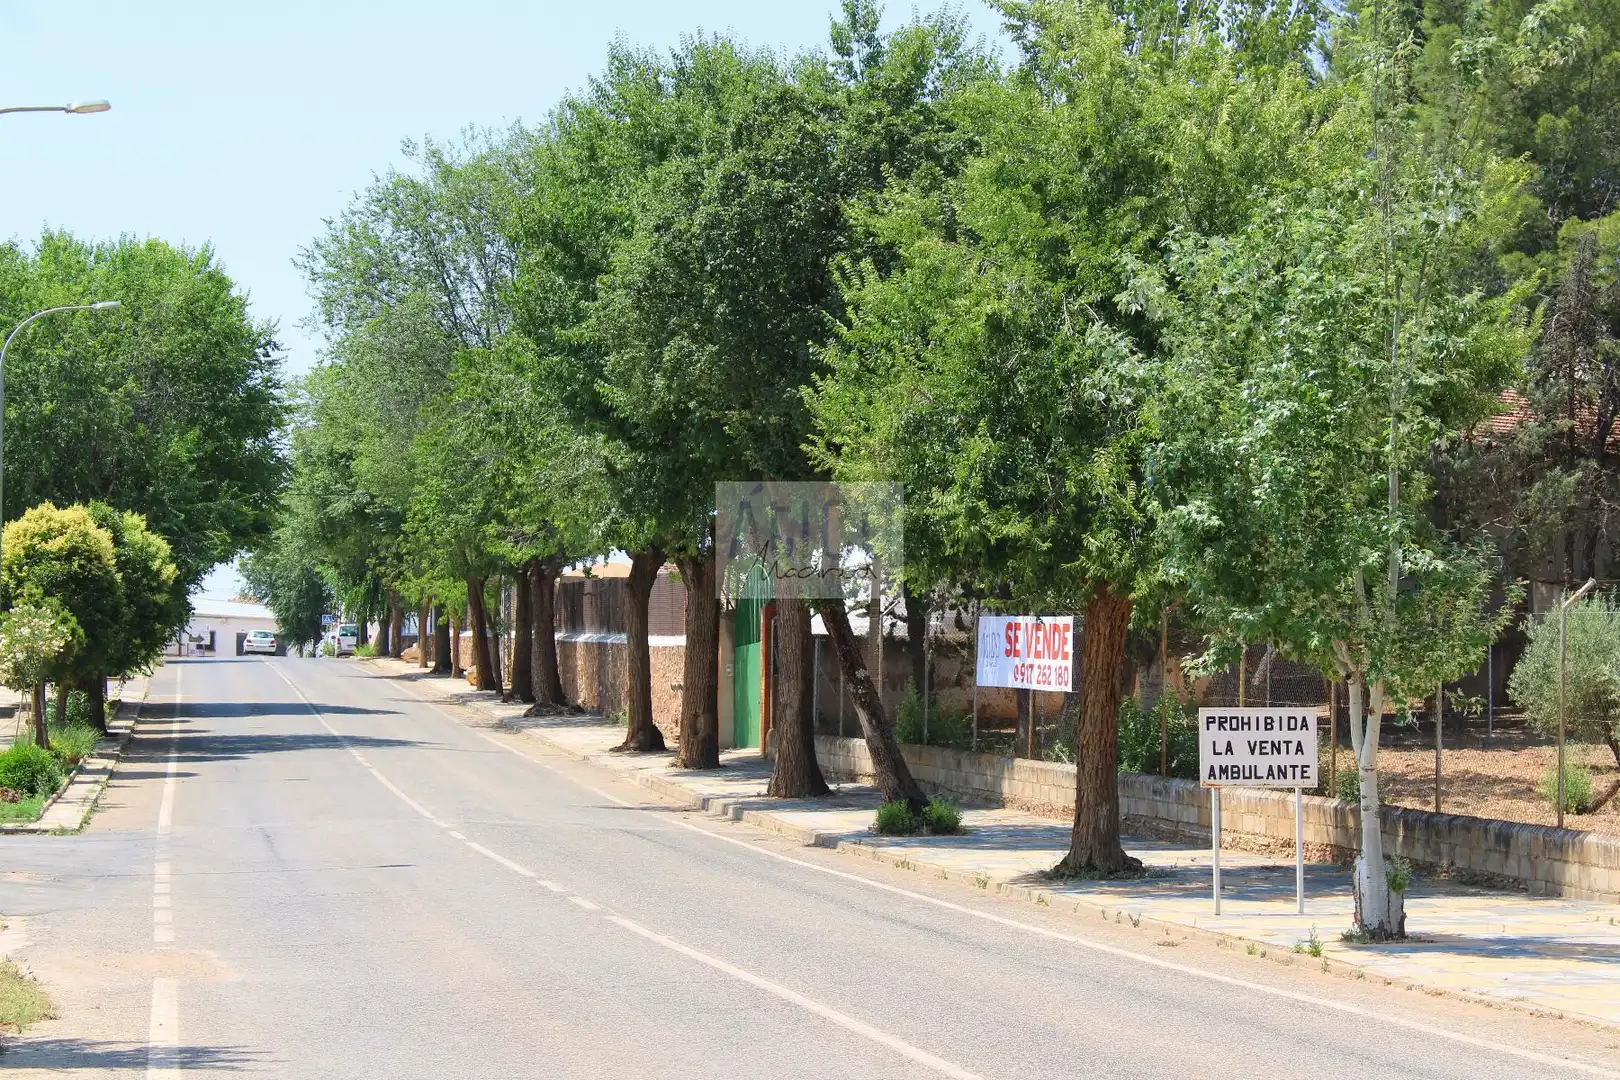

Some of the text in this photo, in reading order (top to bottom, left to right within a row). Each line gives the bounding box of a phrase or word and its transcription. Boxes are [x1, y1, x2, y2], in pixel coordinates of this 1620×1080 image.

[1004, 621, 1021, 657] SE
[1025, 622, 1070, 660] VENDE
[1036, 664, 1051, 685] 262
[1054, 665, 1069, 686] 180
[1206, 716, 1309, 731] PROHIBIDA
[1212, 740, 1304, 755] LA VENTA
[1207, 765, 1311, 780] AMBULANTE
